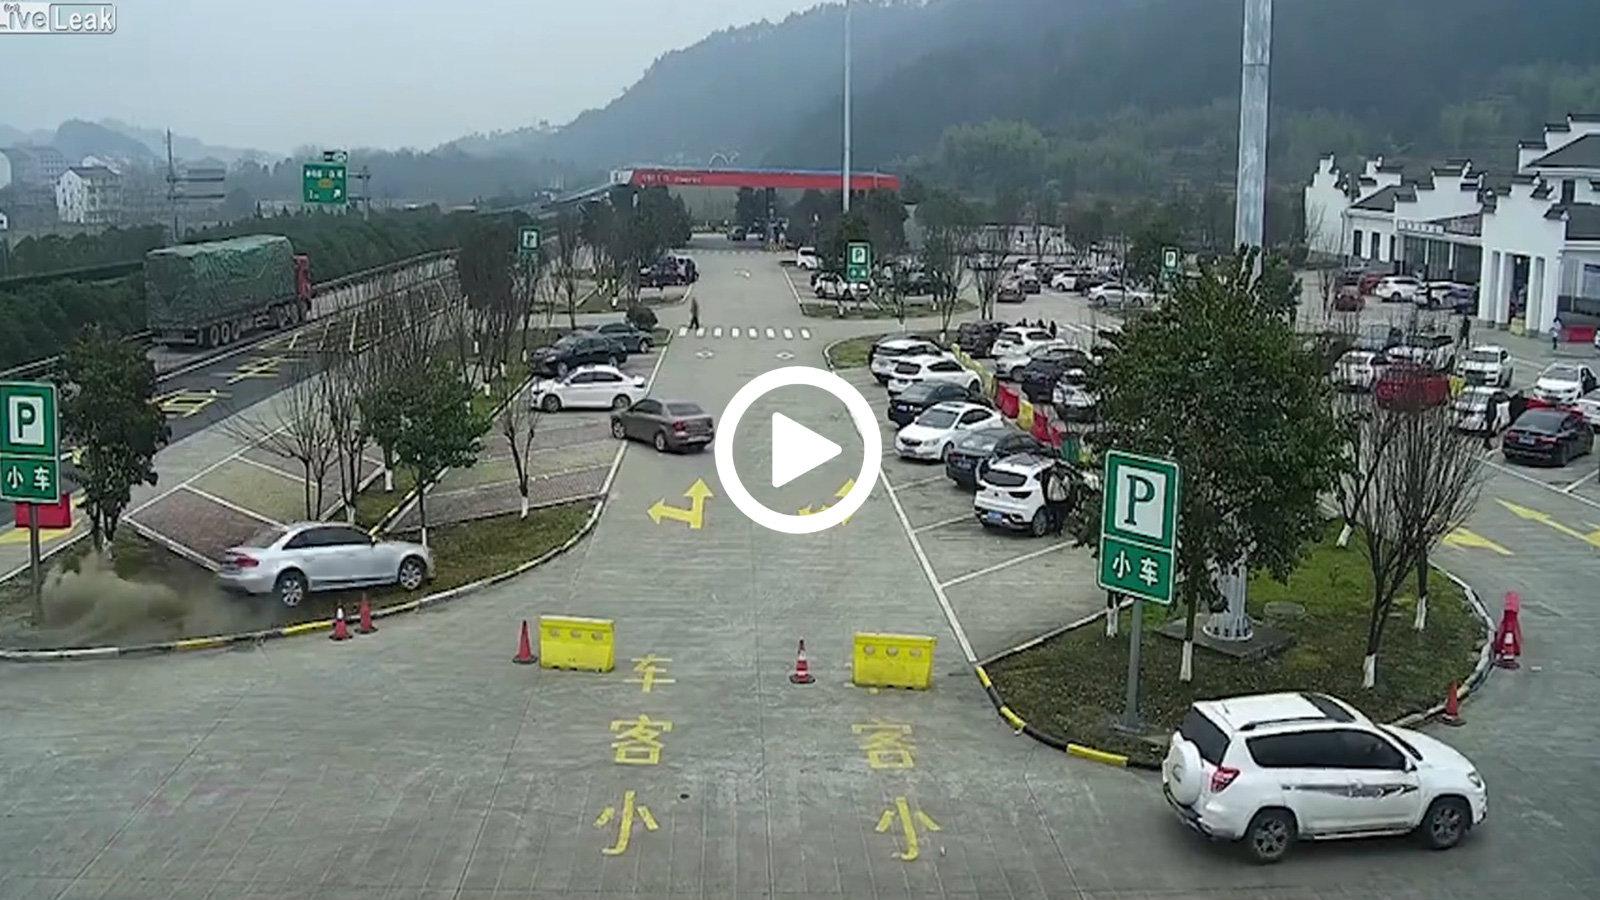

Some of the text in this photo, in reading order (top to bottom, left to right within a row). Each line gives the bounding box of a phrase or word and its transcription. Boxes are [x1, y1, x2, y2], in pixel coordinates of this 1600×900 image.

[17, 402, 36, 439] P
[7, 465, 51, 491] 小车
[1123, 475, 1155, 526] P
[1112, 550, 1159, 587] 小车
